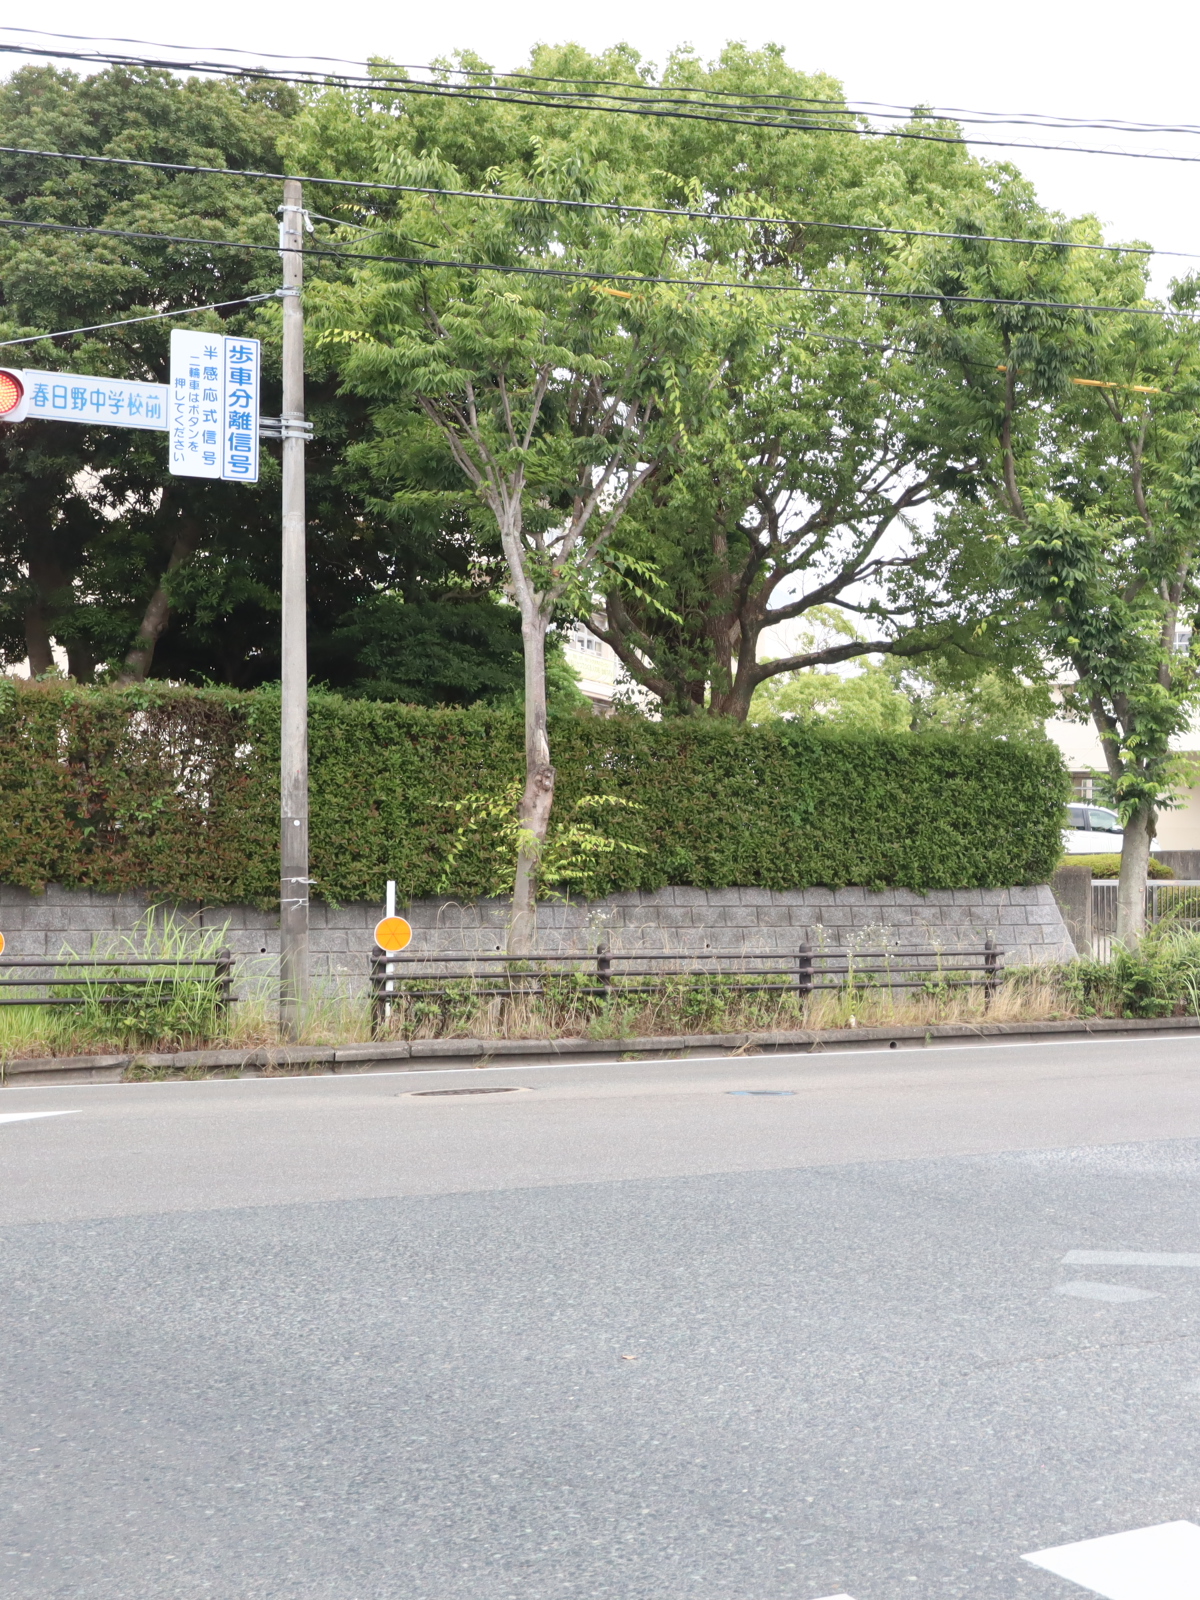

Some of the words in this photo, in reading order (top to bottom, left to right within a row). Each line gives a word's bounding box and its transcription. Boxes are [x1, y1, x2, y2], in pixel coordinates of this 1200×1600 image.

[31, 383, 162, 420] 春日野中学校前
[173, 377, 186, 463] 押してください
[187, 355, 201, 453] 二輪車はボタンを
[201, 345, 218, 466] 半感応式信号
[228, 344, 254, 475] 歩車分離信号
